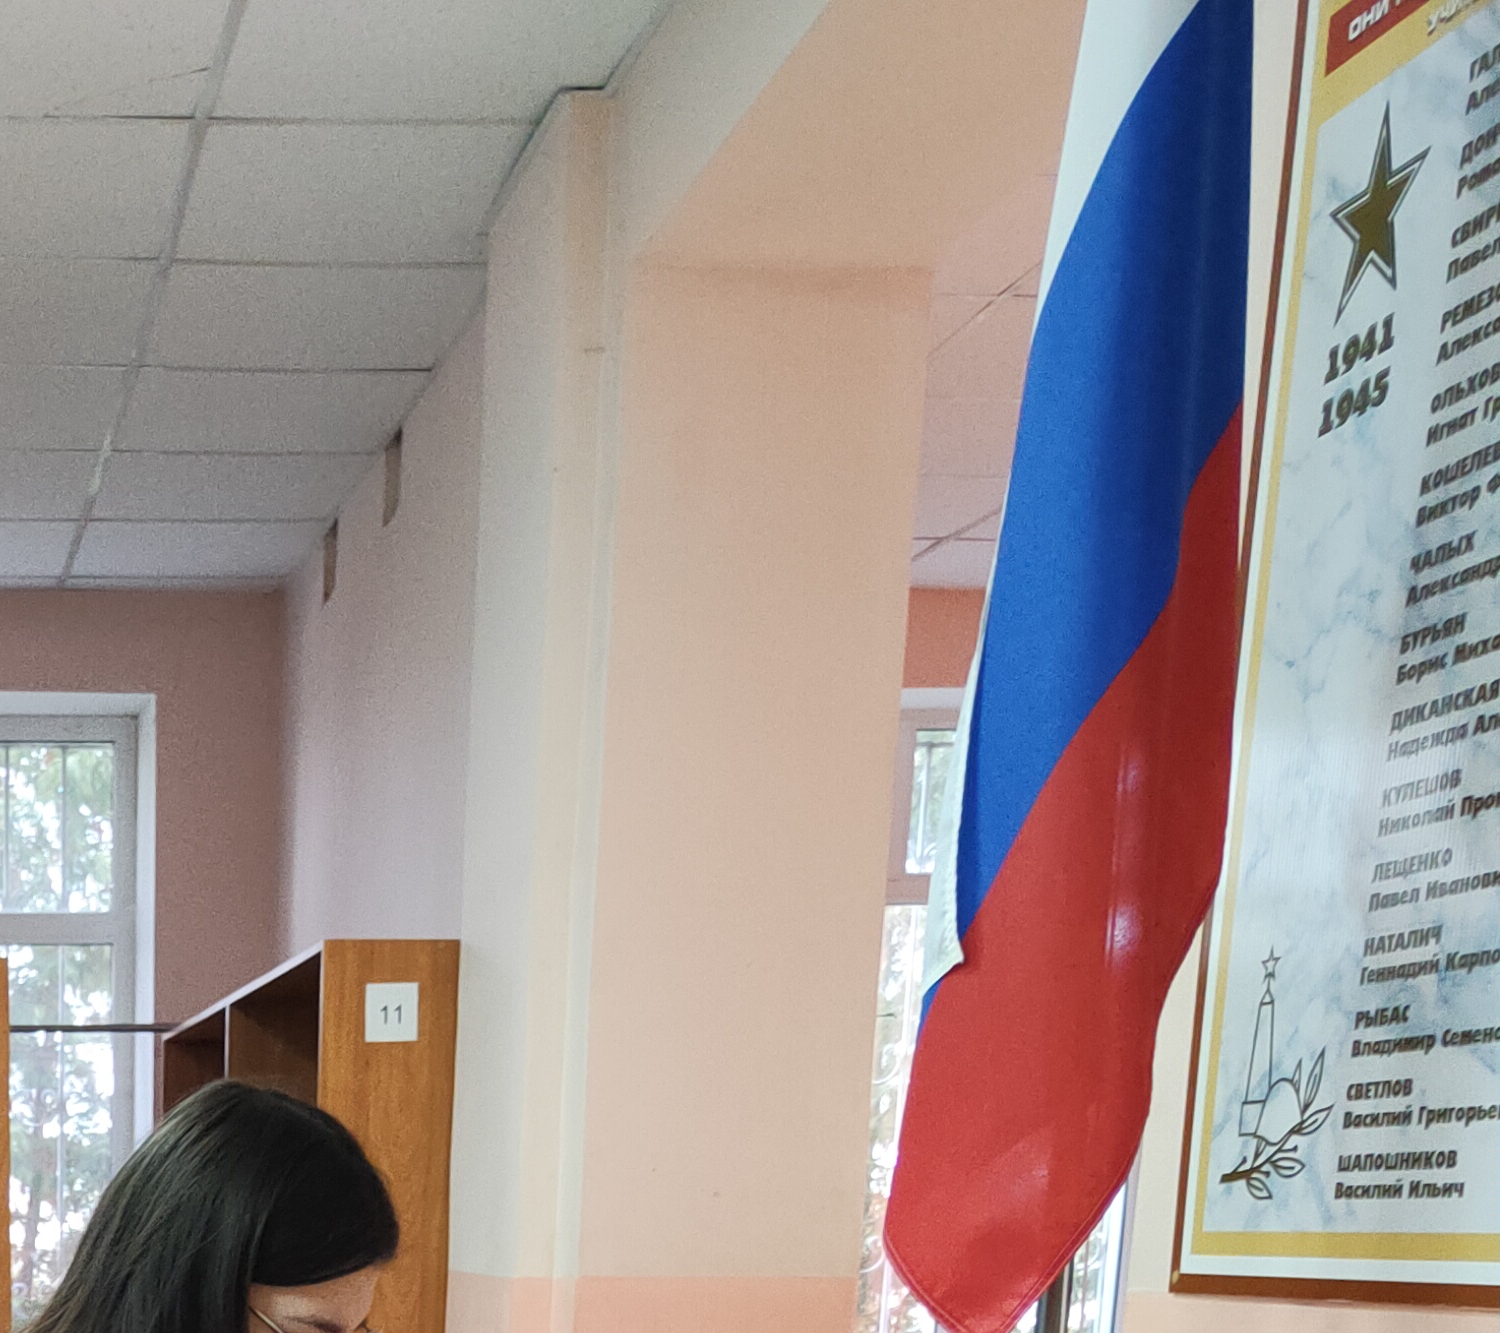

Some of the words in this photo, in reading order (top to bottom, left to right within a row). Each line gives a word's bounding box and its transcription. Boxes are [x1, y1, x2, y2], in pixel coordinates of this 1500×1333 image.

[1324, 312, 1395, 385] 1941
[1317, 365, 1391, 438] 1945
[1426, 406, 1479, 447] Игнат
[1415, 485, 1481, 529] Виктор
[1410, 530, 1478, 575] ЧАЛЫХ
[1399, 612, 1467, 655] БУРЬЯН
[1396, 652, 1448, 686] Борис
[1389, 678, 1500, 736] ДИКАНСКАЯ
[1387, 722, 1469, 762] Надежда
[1382, 769, 1462, 808] КУЛЕШОВ
[1378, 799, 1456, 838] Николай
[1371, 848, 1453, 884] ЛЕЩЕНКО
[1368, 887, 1421, 913] Павел
[1363, 924, 1444, 957] НАТАЛИЧ
[1360, 953, 1441, 986] Геннадий
[380, 1003, 402, 1025] 11
[1354, 1005, 1411, 1030] РЫБАС
[1351, 1034, 1437, 1058] Владимир
[1346, 1078, 1413, 1101] СВЕТЛОВ
[1343, 1104, 1413, 1130] Василий
[1337, 1150, 1458, 1172] ШАПОШНИКОВ
[1334, 1178, 1404, 1200] Василий
[1408, 1180, 1465, 1199] Ильич
